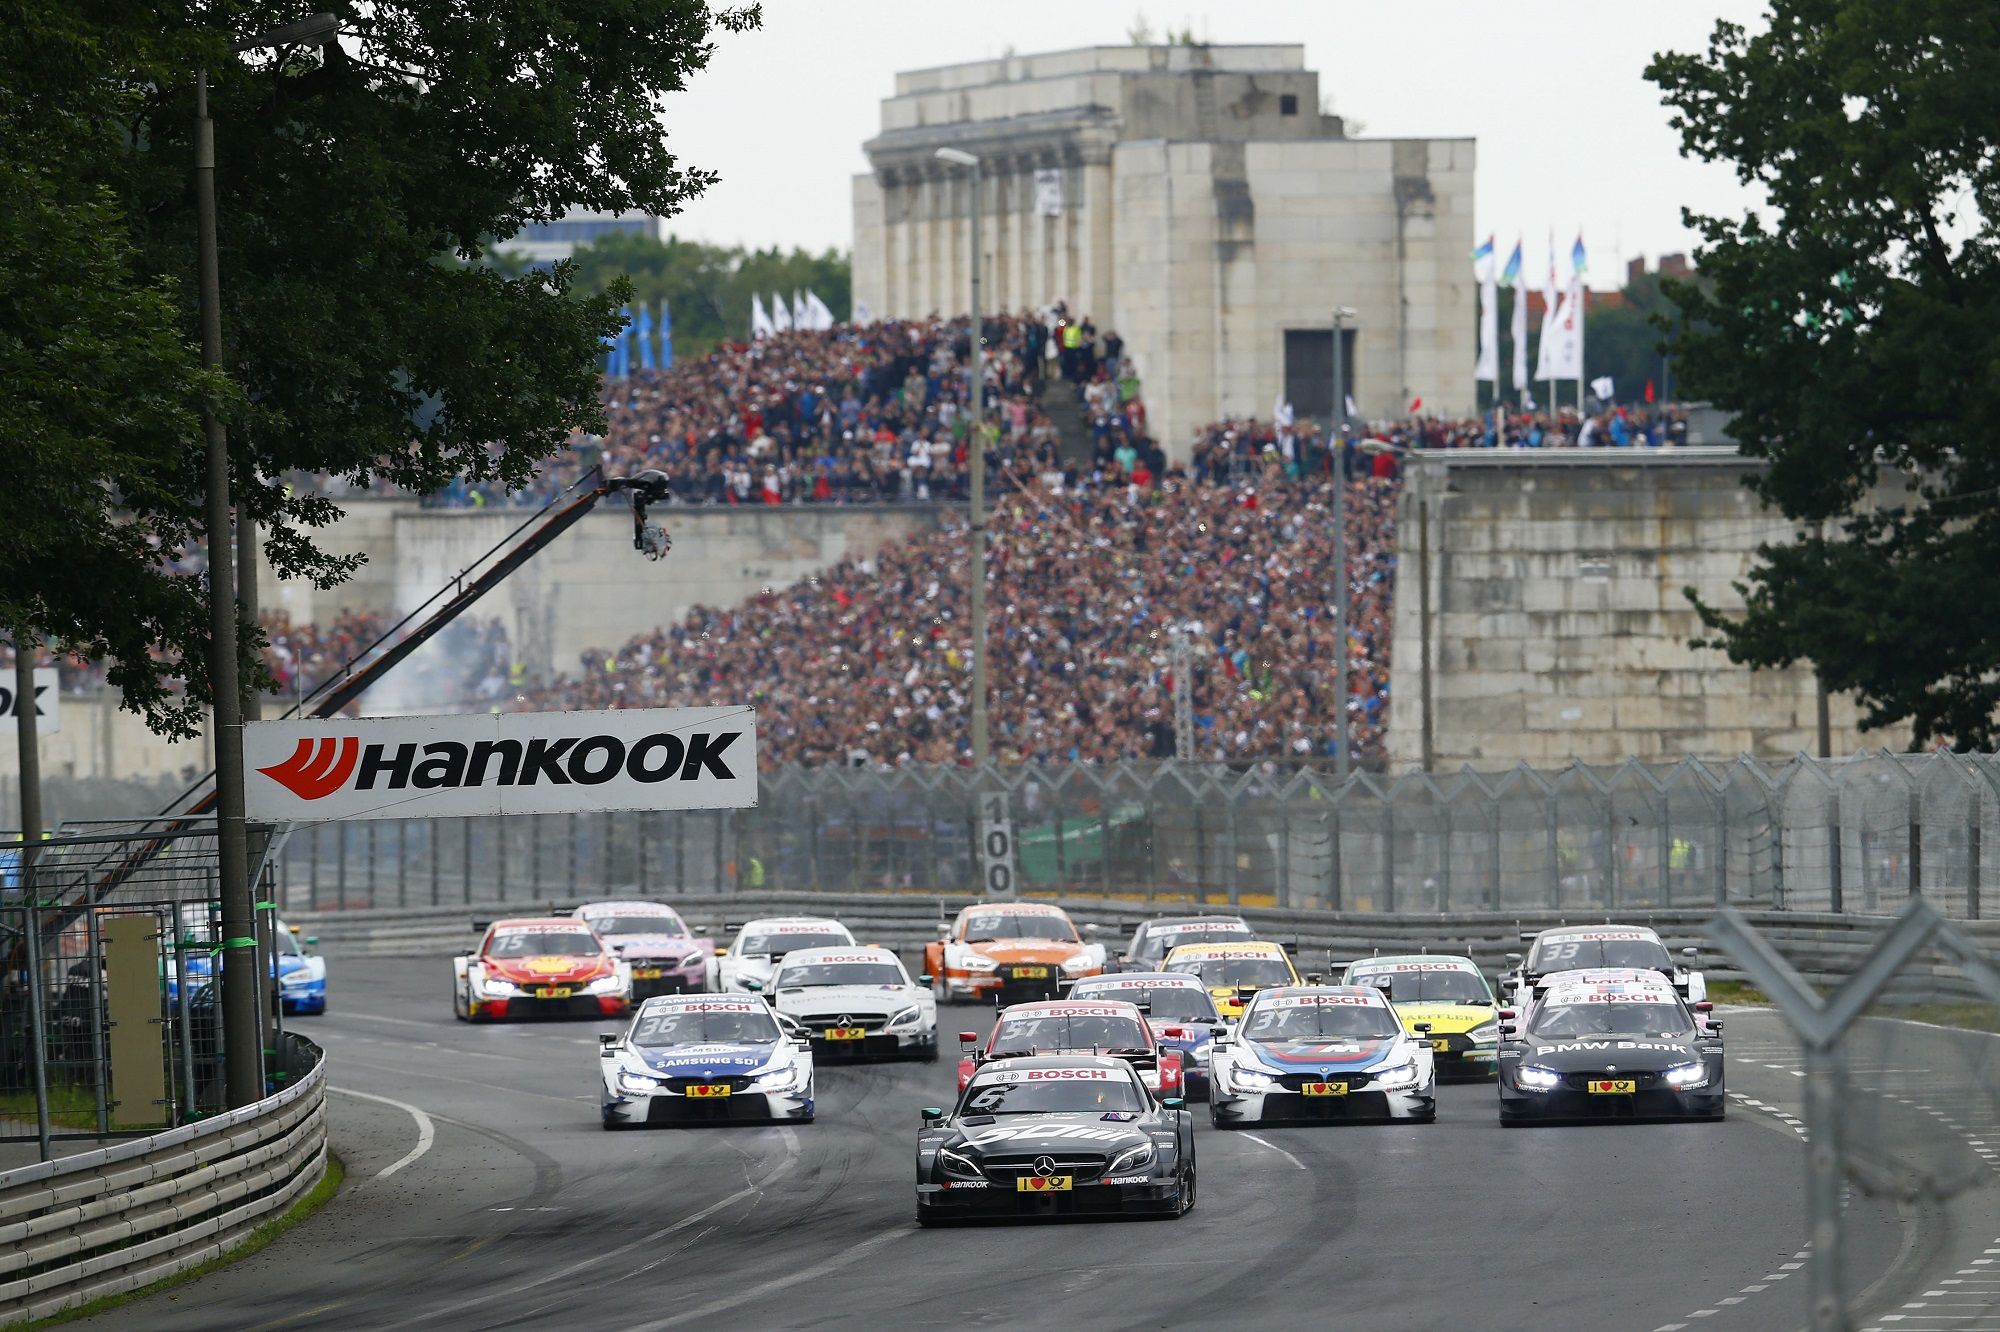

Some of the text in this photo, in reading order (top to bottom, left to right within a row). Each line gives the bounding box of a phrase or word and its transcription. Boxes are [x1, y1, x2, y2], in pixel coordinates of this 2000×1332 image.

[986, 796, 1010, 891] 100
[971, 916, 1002, 931] 53
[1181, 923, 1235, 931] BOSCH
[749, 936, 767, 948] 3
[1543, 943, 1580, 961] 33
[1396, 963, 1459, 971] BOSCH
[782, 969, 809, 983] 2
[1121, 980, 1184, 988] BOSCH
[1300, 995, 1368, 1005] BOSCH
[1588, 994, 1659, 1002] BOSCH
[684, 1003, 751, 1012] BOSCH
[1049, 1007, 1117, 1016] BOSCH
[1253, 1009, 1292, 1031] 31
[1540, 1006, 1572, 1028] 7
[639, 1016, 683, 1036] 36
[1001, 1020, 1043, 1040] 51
[1536, 1041, 1610, 1057] BMW
[1617, 1041, 1687, 1055] Bank
[656, 1057, 759, 1068] SAMSUNG SDI
[1027, 1070, 1107, 1080] BOSCH
[969, 1086, 1010, 1108] 6
